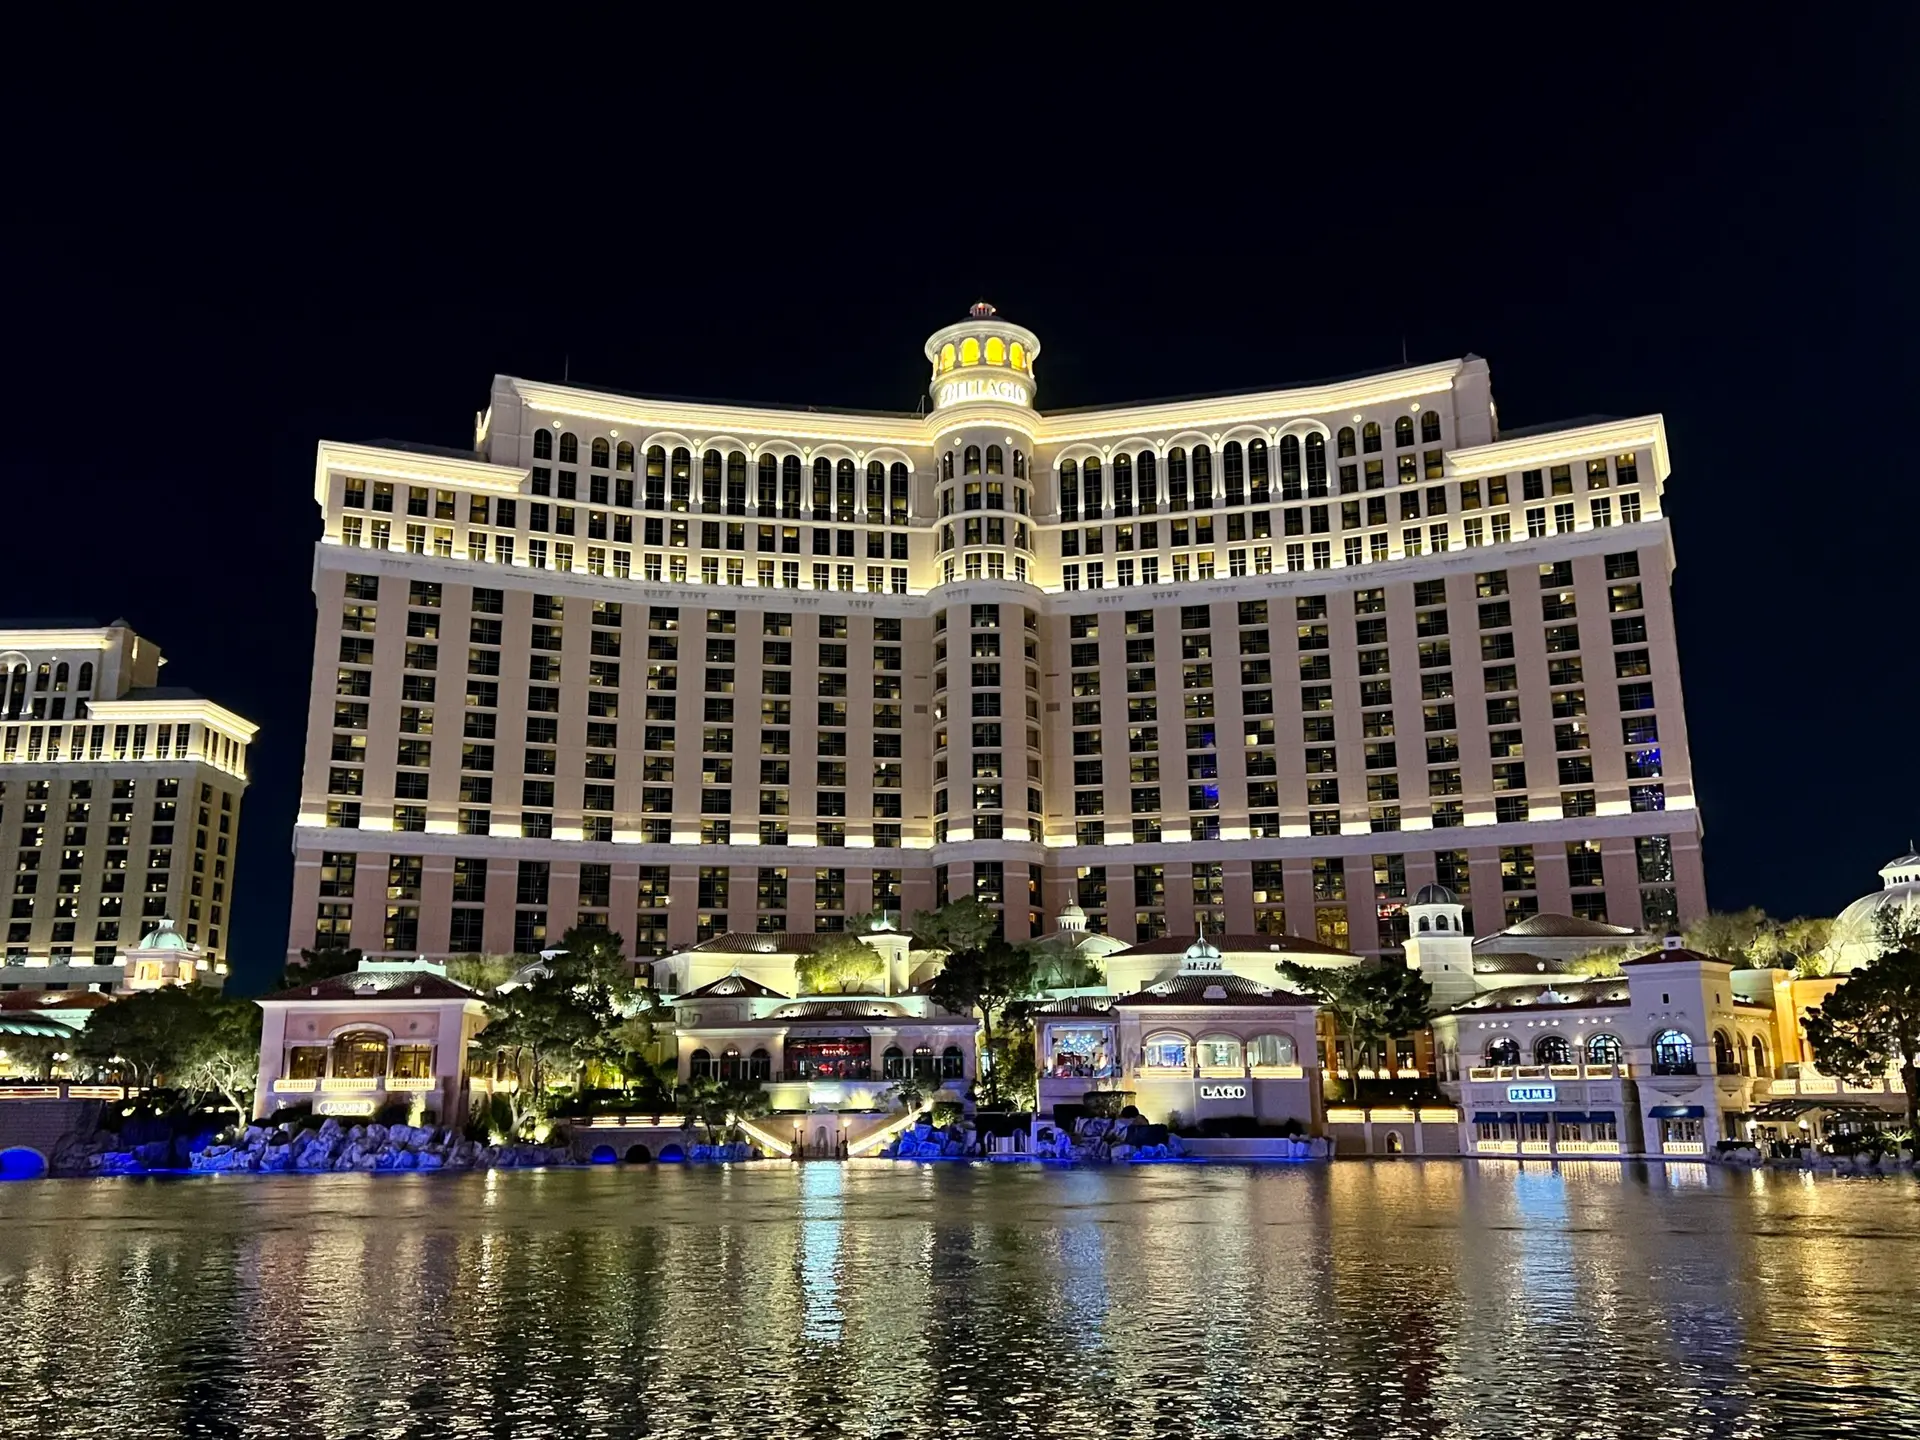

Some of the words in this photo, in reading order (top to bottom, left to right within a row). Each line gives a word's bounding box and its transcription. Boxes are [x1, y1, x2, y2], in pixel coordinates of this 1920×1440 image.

[939, 379, 1028, 404] BELLAGIO
[1202, 1087, 1245, 1098] LAGO
[1510, 1088, 1552, 1100] PRIME
[323, 1102, 369, 1114] JASMINE
